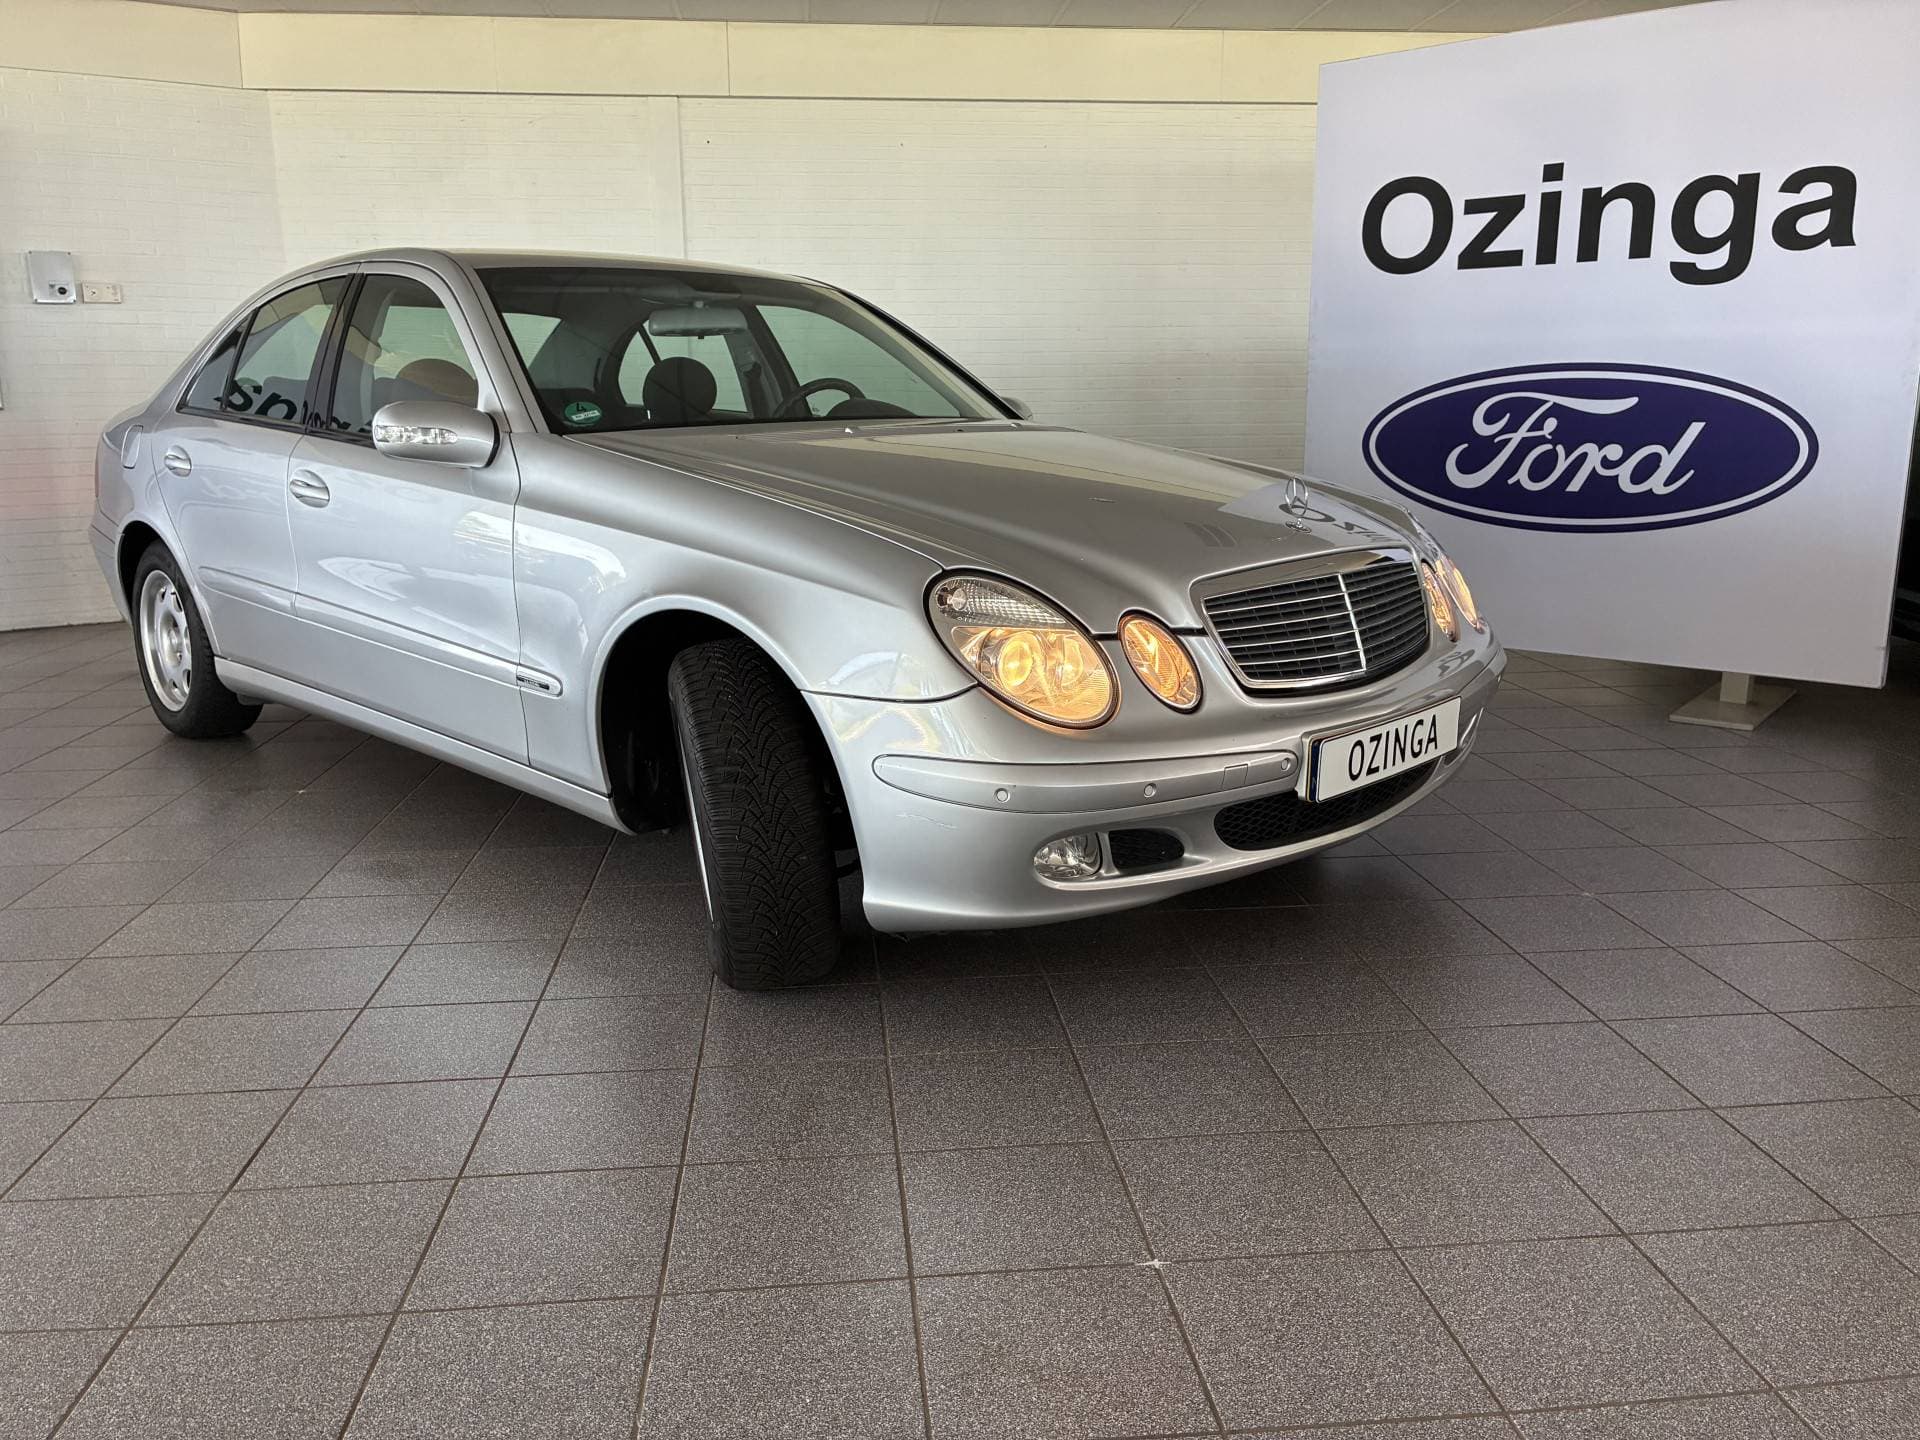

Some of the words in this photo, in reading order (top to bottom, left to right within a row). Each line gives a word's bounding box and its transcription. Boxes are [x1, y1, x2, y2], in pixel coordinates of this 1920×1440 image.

[1361, 161, 1858, 286] Ozinga
[1444, 390, 1706, 496] Ford
[1348, 714, 1439, 781] OZINGA
